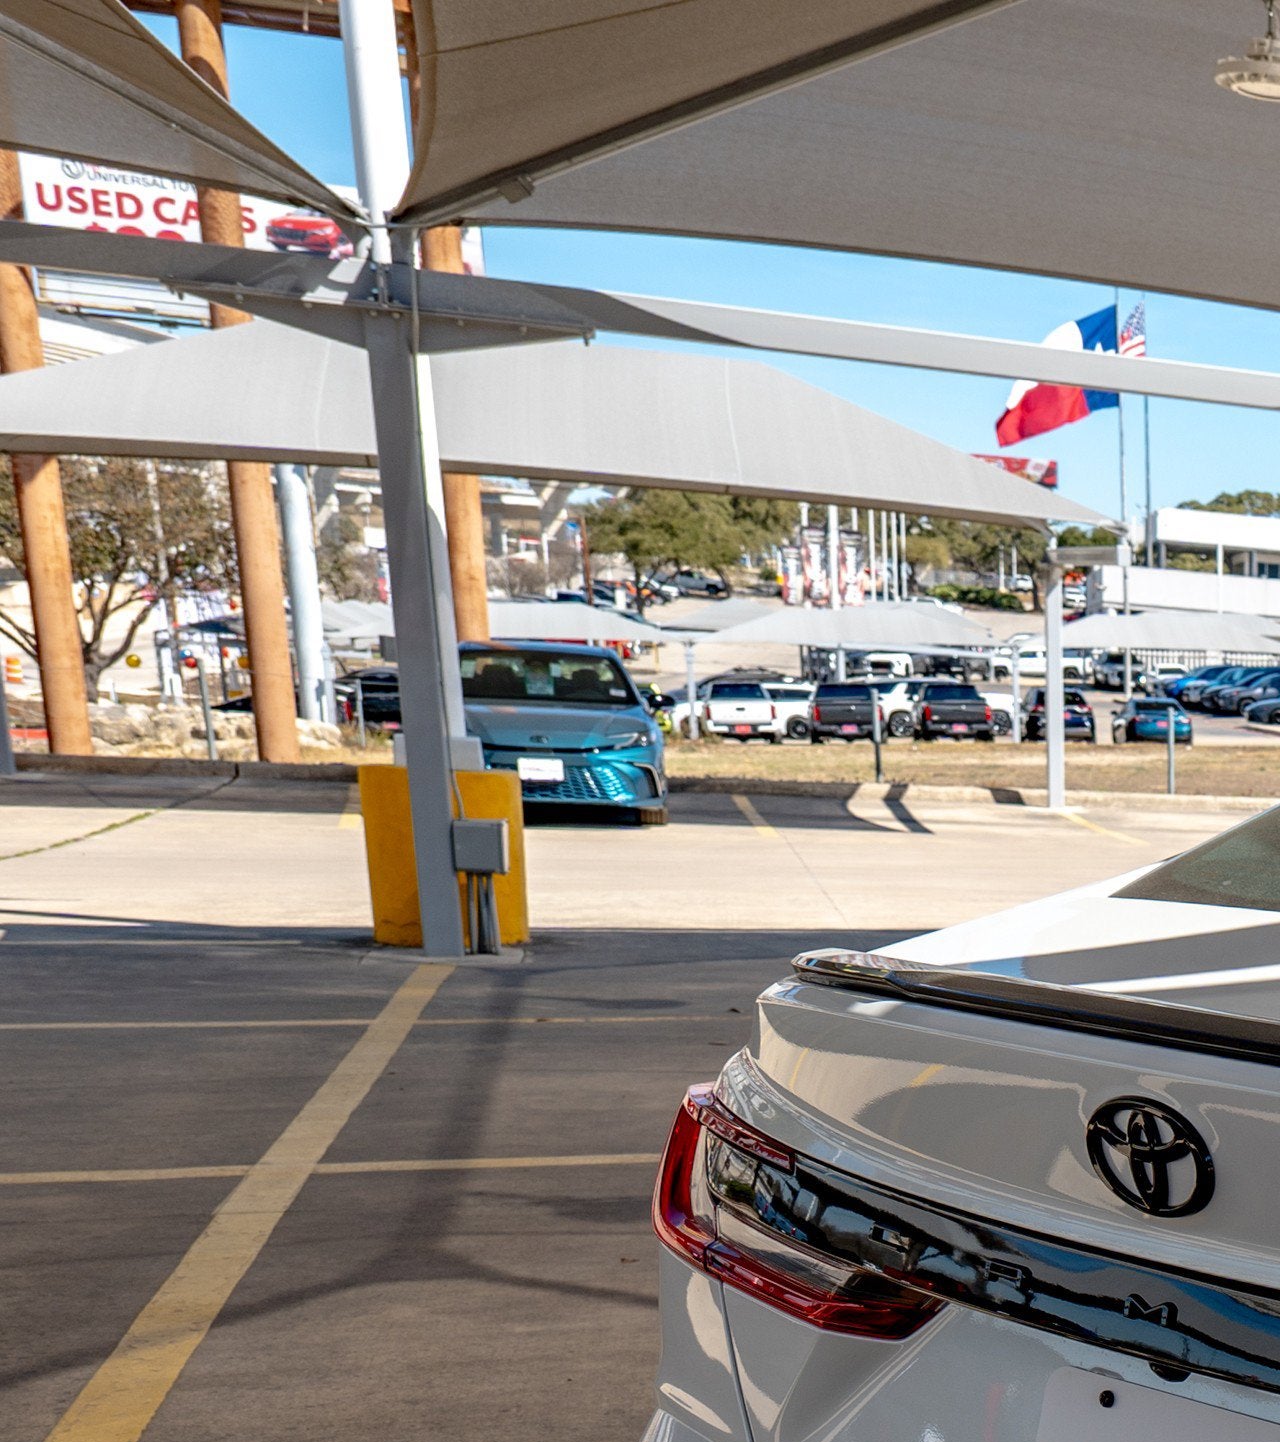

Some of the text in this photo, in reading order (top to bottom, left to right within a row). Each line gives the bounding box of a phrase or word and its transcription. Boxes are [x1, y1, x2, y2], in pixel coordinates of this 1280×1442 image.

[87, 170, 167, 189] UNIVERSAL
[35, 182, 144, 220] USED
[152, 196, 257, 234] CAS
